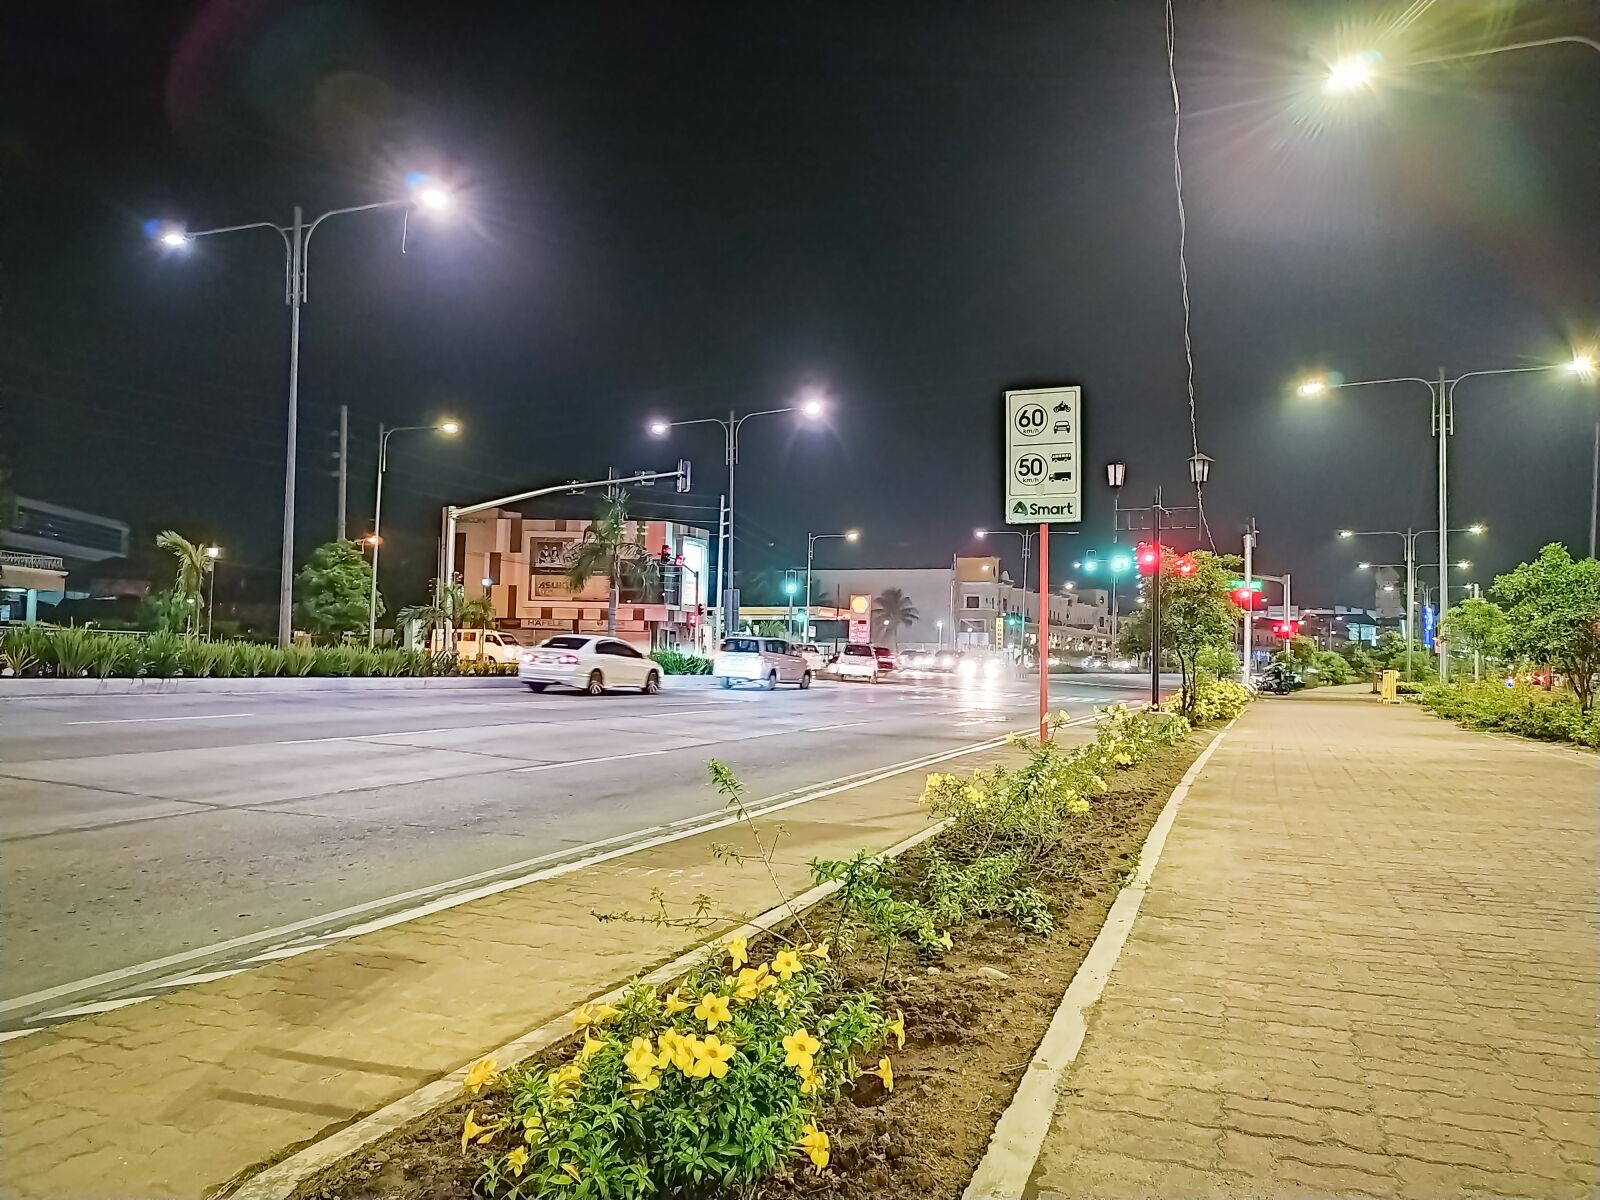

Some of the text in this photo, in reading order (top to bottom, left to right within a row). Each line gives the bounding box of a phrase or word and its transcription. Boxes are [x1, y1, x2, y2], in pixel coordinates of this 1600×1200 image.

[1018, 408, 1044, 428] 60
[1017, 457, 1043, 477] 50
[1029, 501, 1073, 516] Smart
